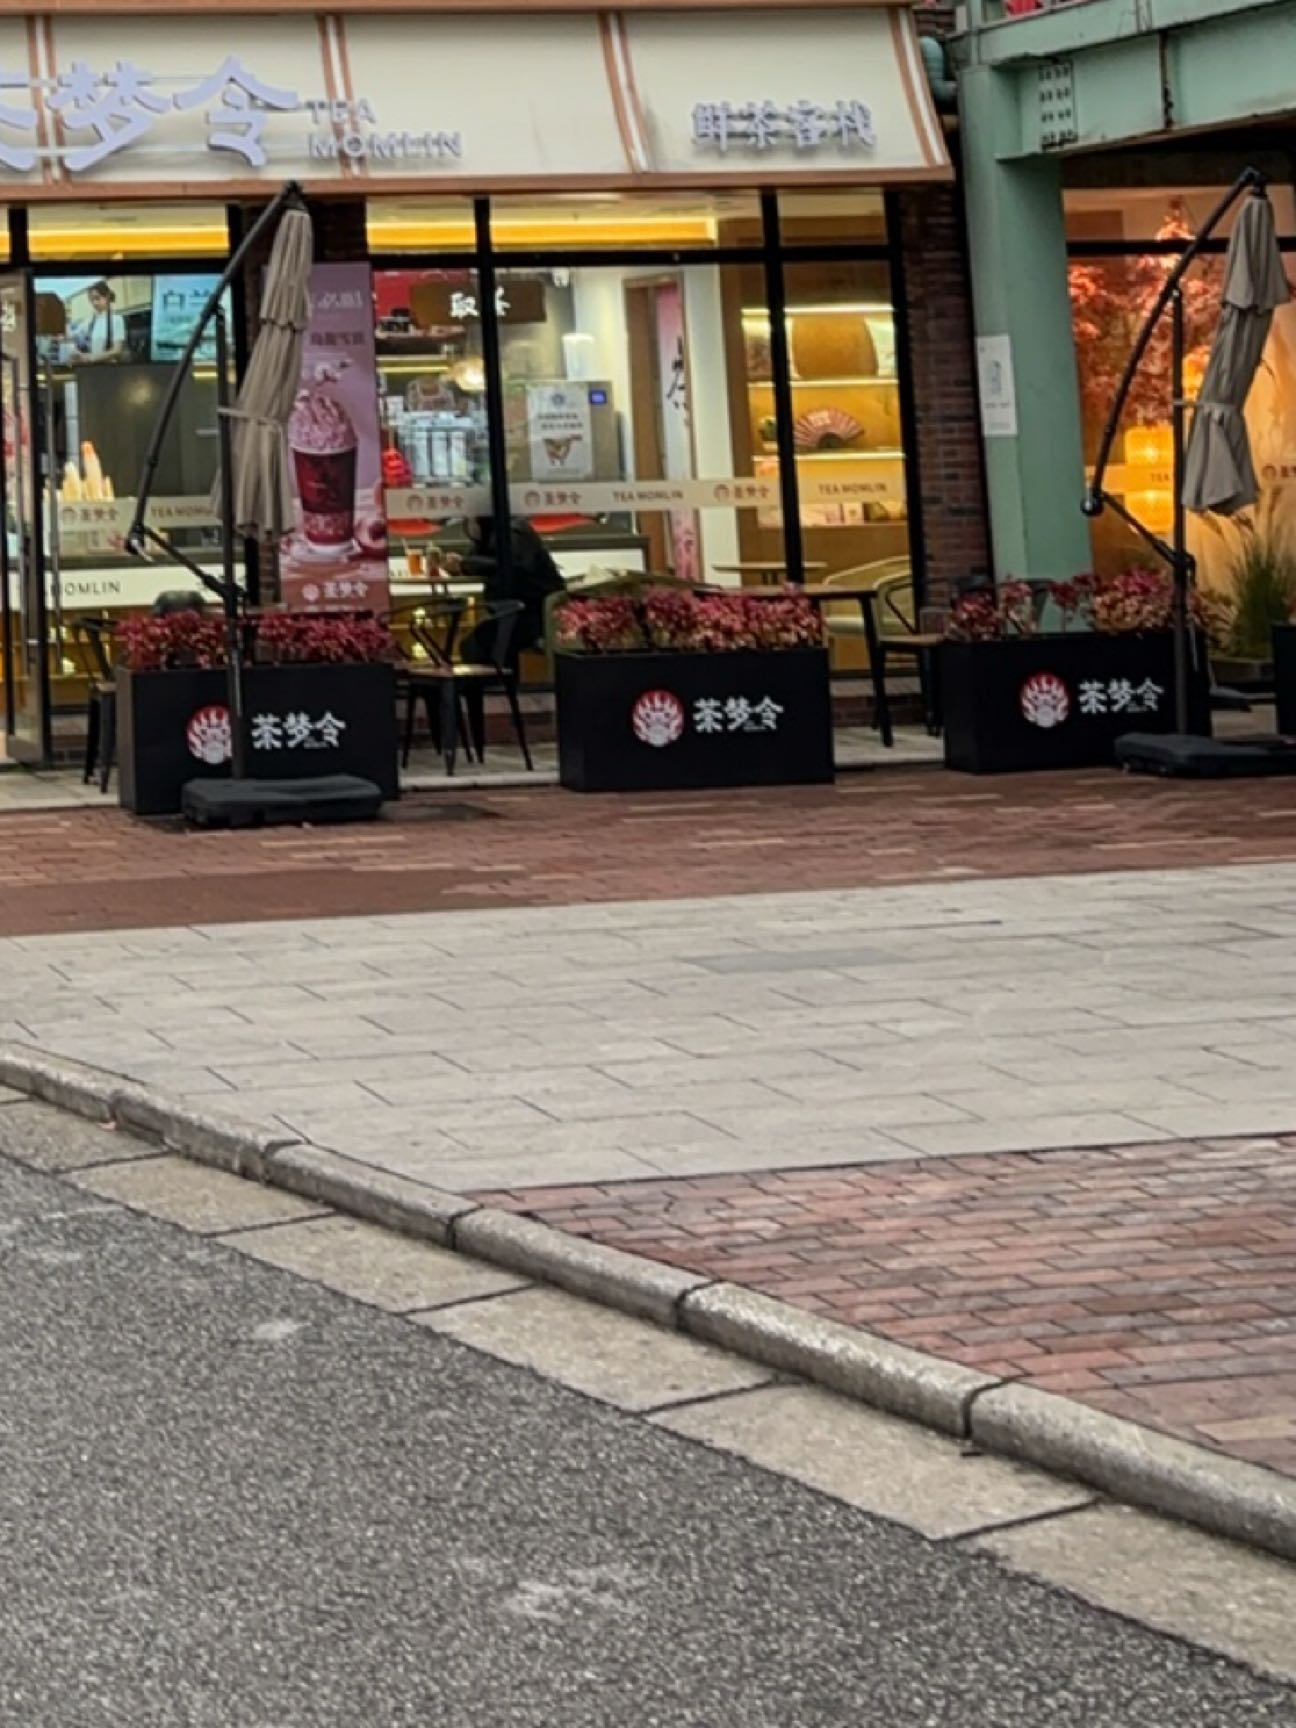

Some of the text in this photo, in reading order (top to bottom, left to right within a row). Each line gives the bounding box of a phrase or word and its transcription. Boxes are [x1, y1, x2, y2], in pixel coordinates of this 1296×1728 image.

[306, 98, 376, 124] TEA
[309, 131, 462, 160] MOMLIN
[51, 582, 121, 596] OMLIN
[1077, 677, 1165, 714] 茶梦令
[251, 711, 347, 750] 茶梦令
[692, 696, 784, 734] 茶梦令
